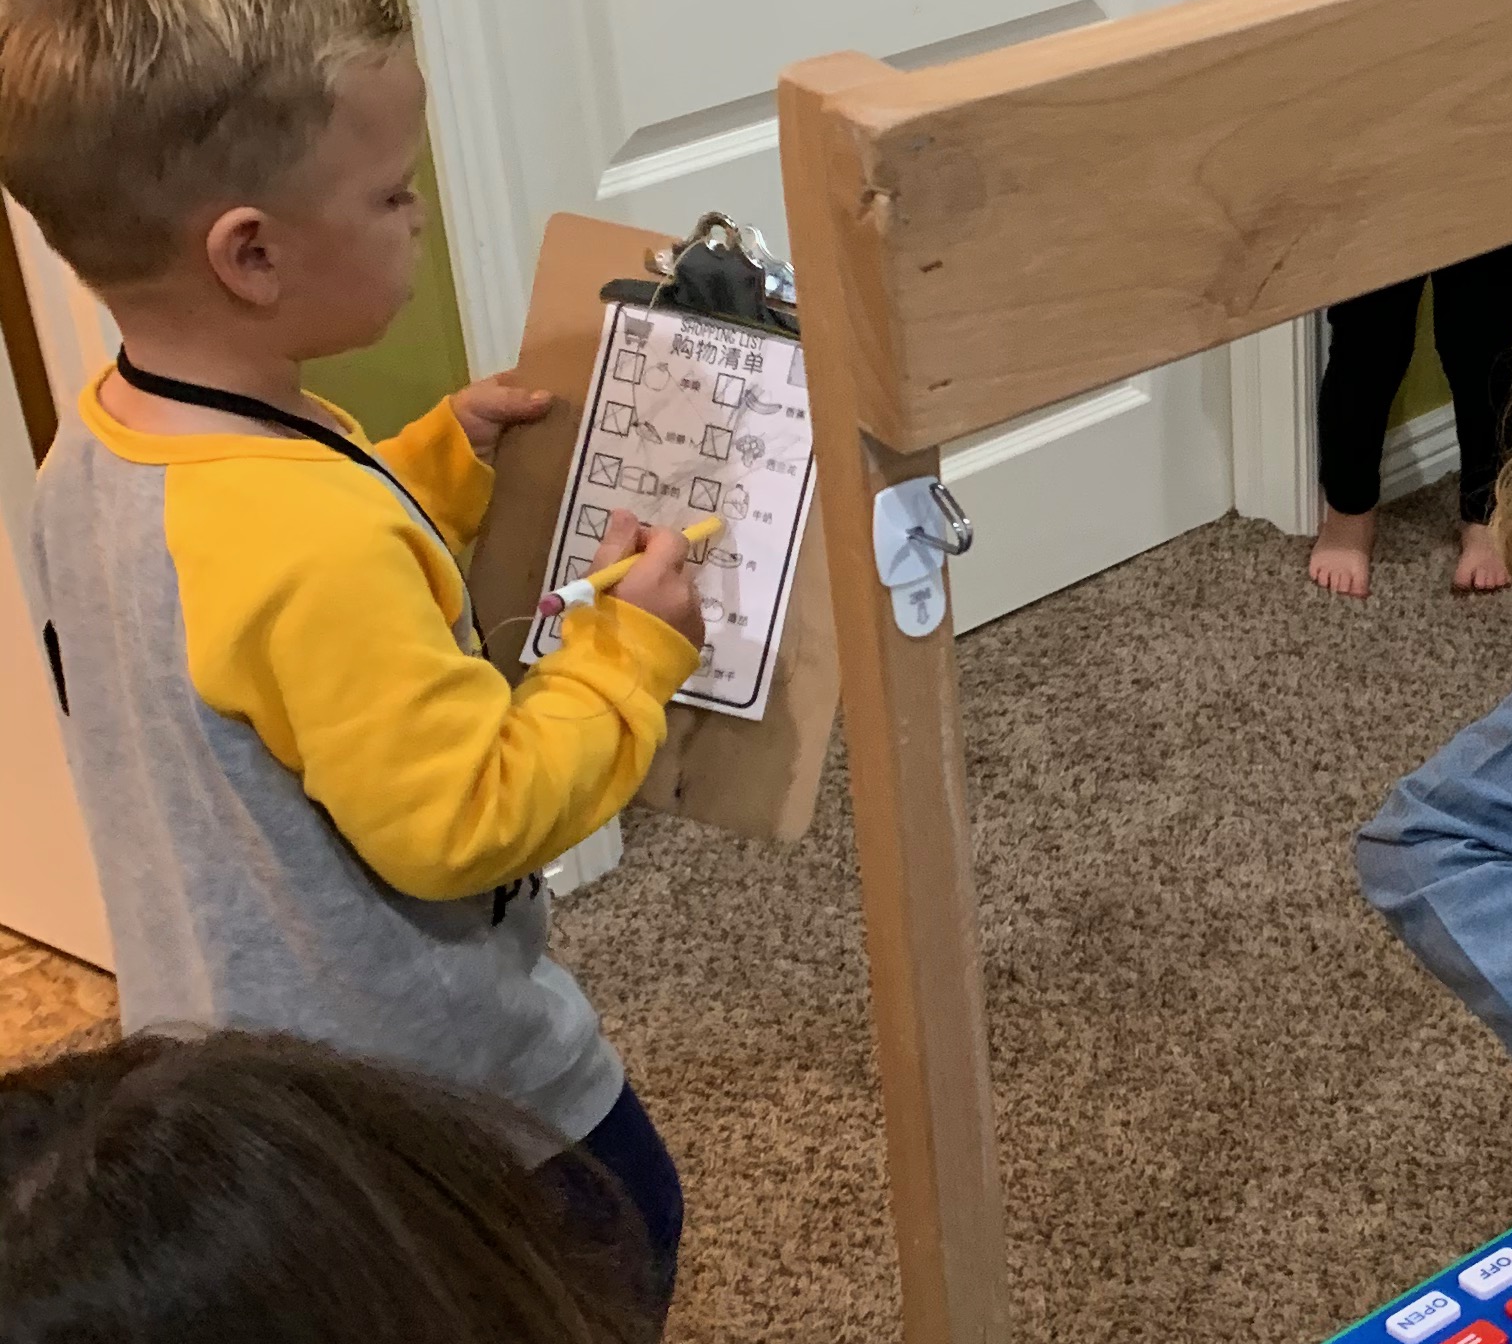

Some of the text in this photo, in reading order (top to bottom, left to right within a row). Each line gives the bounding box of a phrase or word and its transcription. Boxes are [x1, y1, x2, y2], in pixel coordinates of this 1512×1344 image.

[670, 333, 763, 374] 购物清单
[1478, 1256, 1512, 1280] OFF
[1397, 1296, 1448, 1331] OPEN
